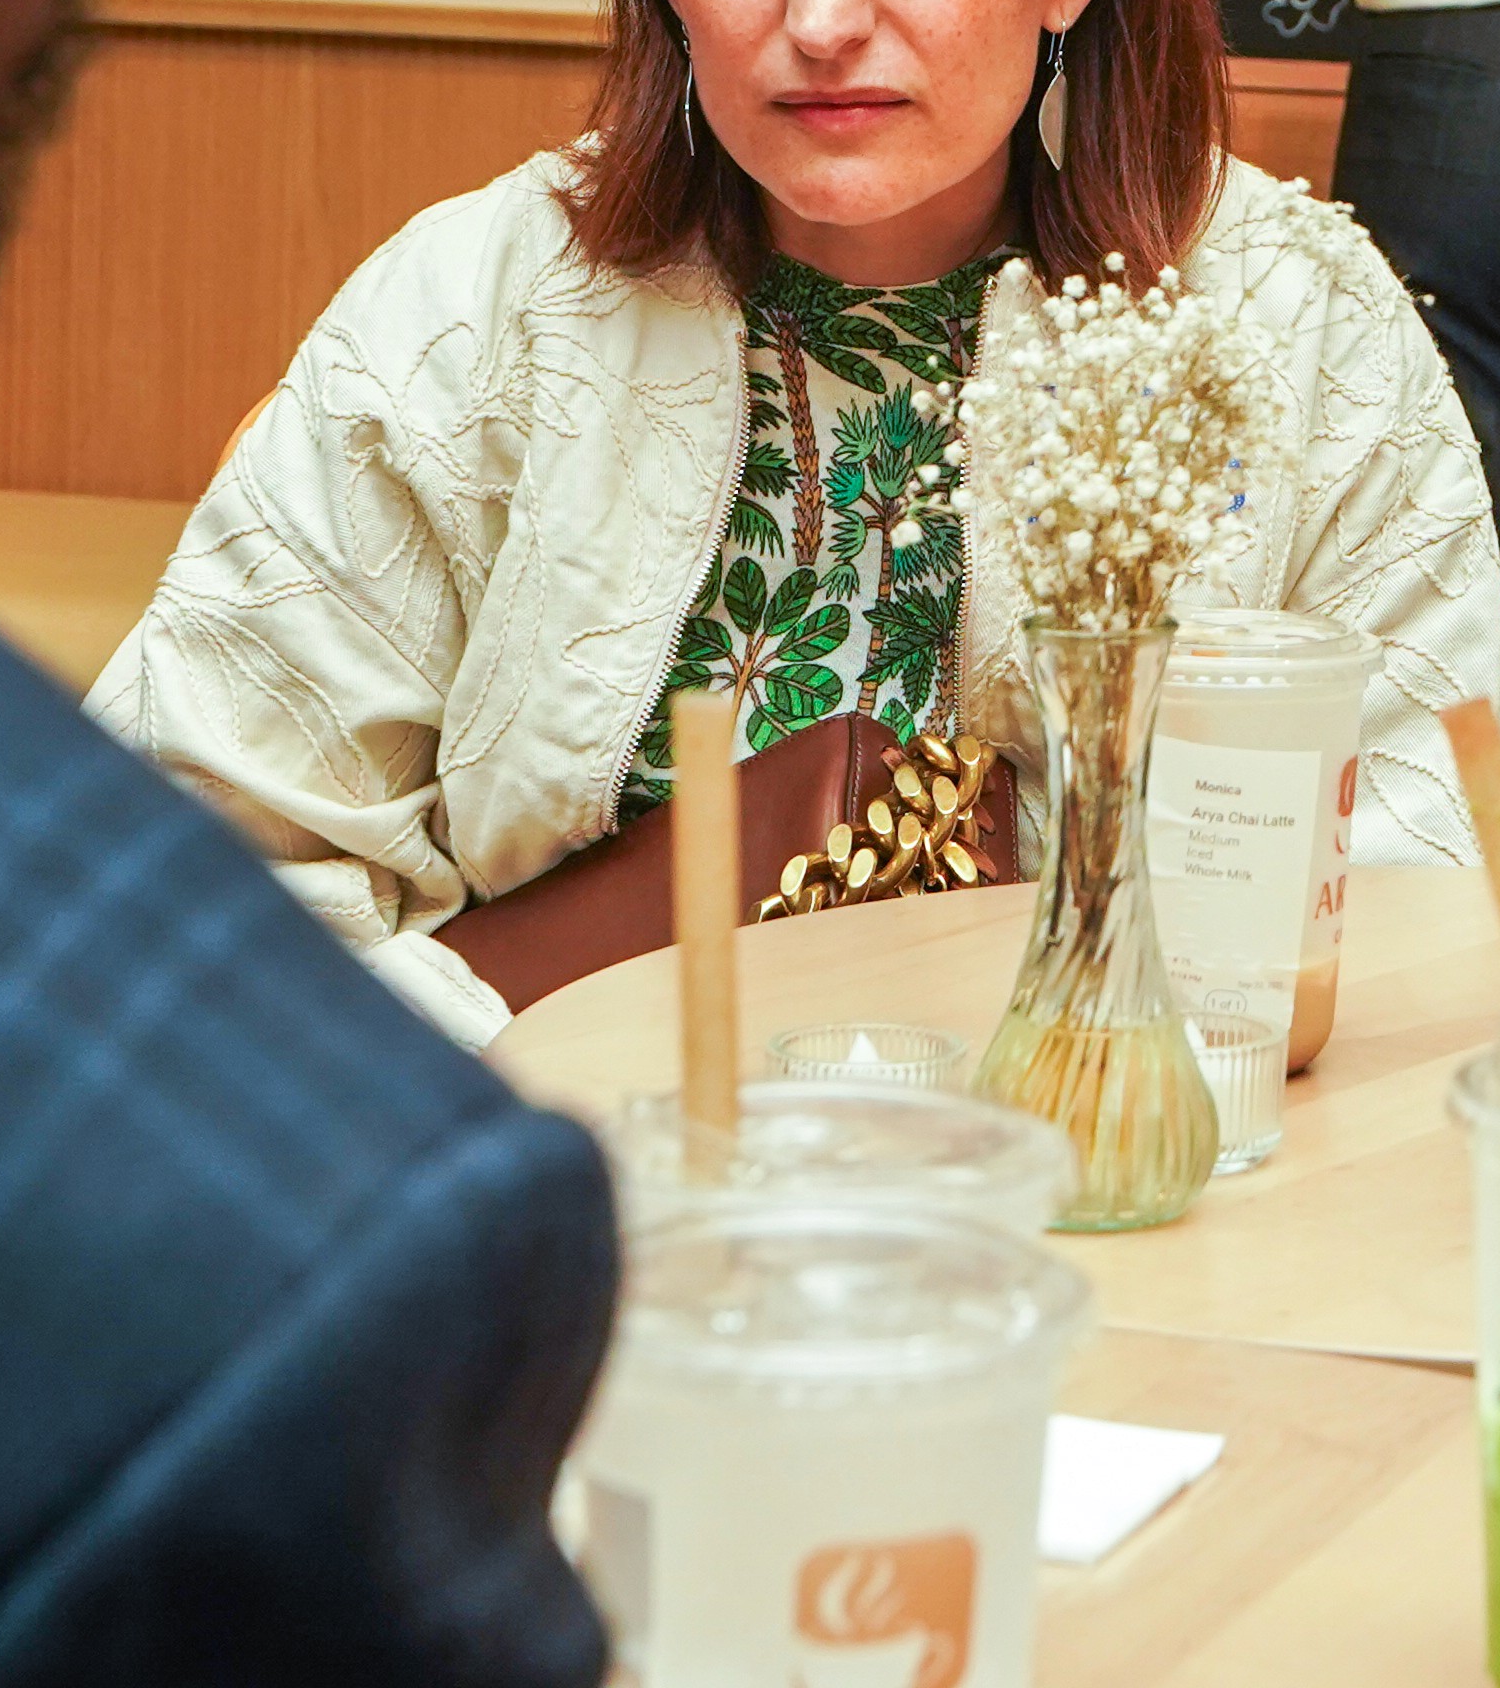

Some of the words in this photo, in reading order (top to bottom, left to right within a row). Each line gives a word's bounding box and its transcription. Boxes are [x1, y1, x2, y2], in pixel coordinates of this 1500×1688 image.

[1195, 779, 1242, 795] Monica
[1191, 807, 1224, 823] Arya
[1228, 811, 1259, 825] Chai
[1263, 814, 1295, 827] Latte
[1189, 829, 1240, 846] Medium
[1186, 846, 1213, 860] Iced
[1185, 863, 1223, 878] Whole
[1227, 869, 1252, 882] Milk
[1220, 999, 1231, 1011] of
